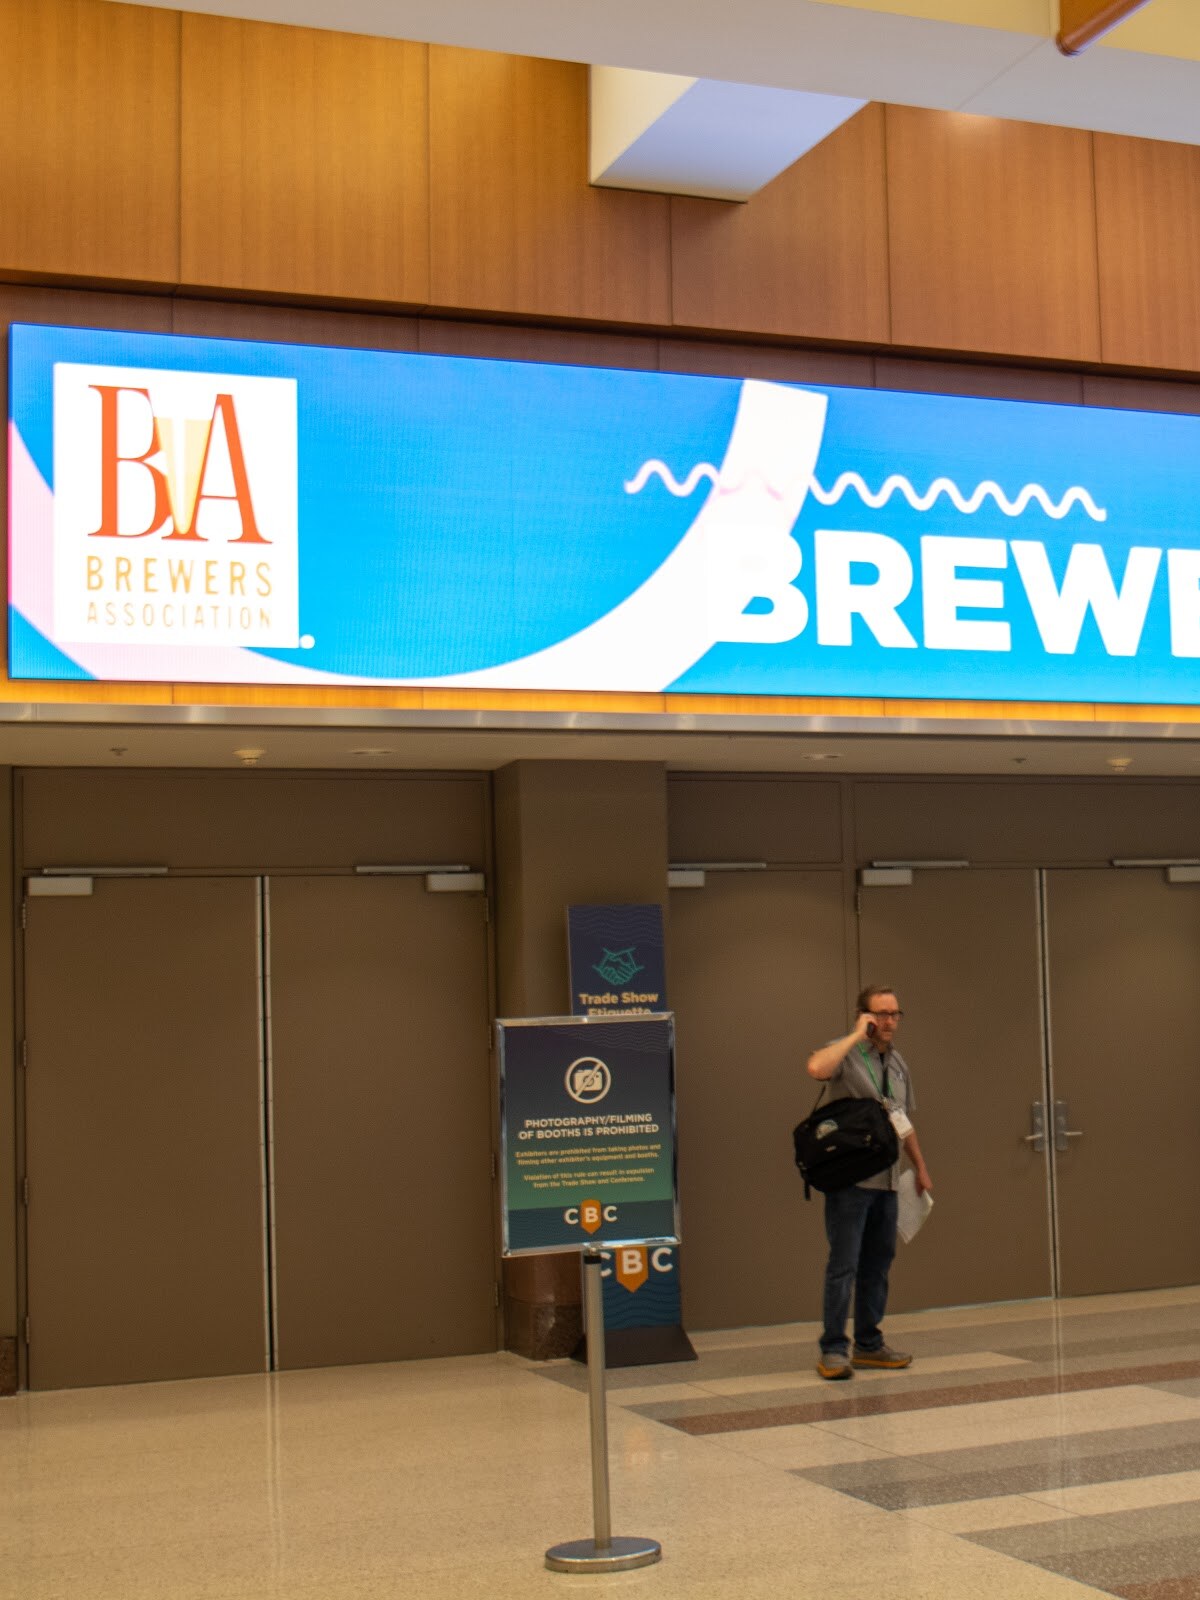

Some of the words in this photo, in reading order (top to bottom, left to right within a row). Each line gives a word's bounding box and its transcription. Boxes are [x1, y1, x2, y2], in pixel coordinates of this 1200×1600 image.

[86, 554, 273, 597] BREWERS
[86, 602, 272, 630] ASSOCIATION
[579, 992, 618, 1005] Trade
[621, 992, 659, 1004] Show
[524, 1113, 653, 1128] PHOTOGRAPHY/FILMING
[518, 1130, 535, 1140] OF
[537, 1128, 581, 1140] BOOTHS
[583, 1127, 594, 1137] IS
[596, 1124, 660, 1136] PROHIBITED
[564, 1205, 618, 1225] CBC
